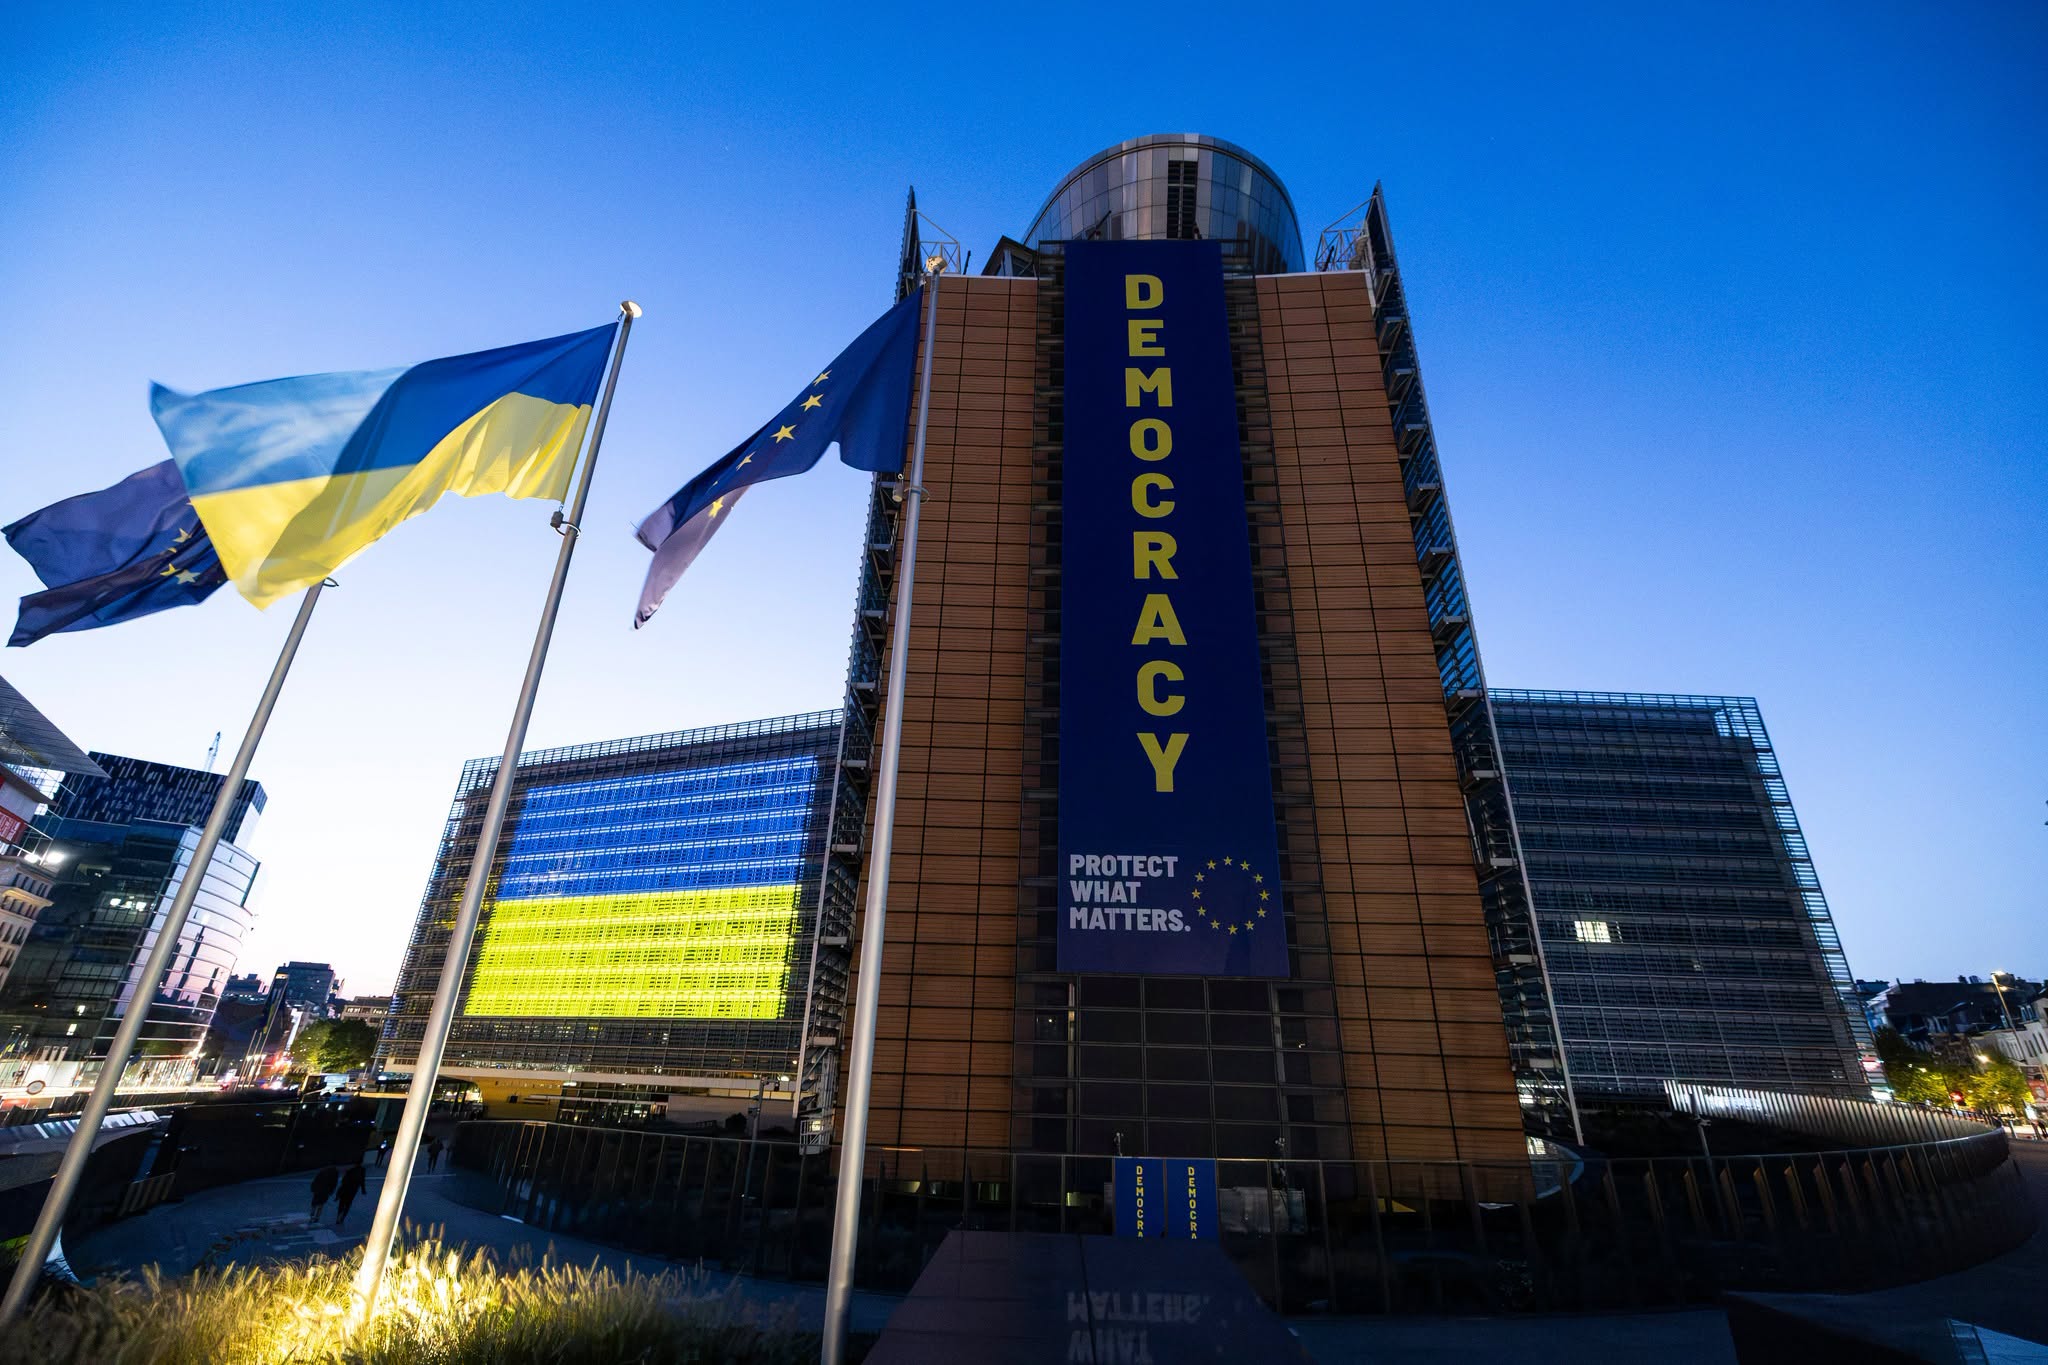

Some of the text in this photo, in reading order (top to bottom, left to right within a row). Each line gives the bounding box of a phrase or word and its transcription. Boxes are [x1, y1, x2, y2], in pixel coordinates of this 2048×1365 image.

[1125, 274, 1189, 792] DEMOCRACY
[1070, 854, 1179, 878] PROTECT
[1070, 880, 1142, 904] WHAT
[1069, 907, 1191, 932] MATTERS.
